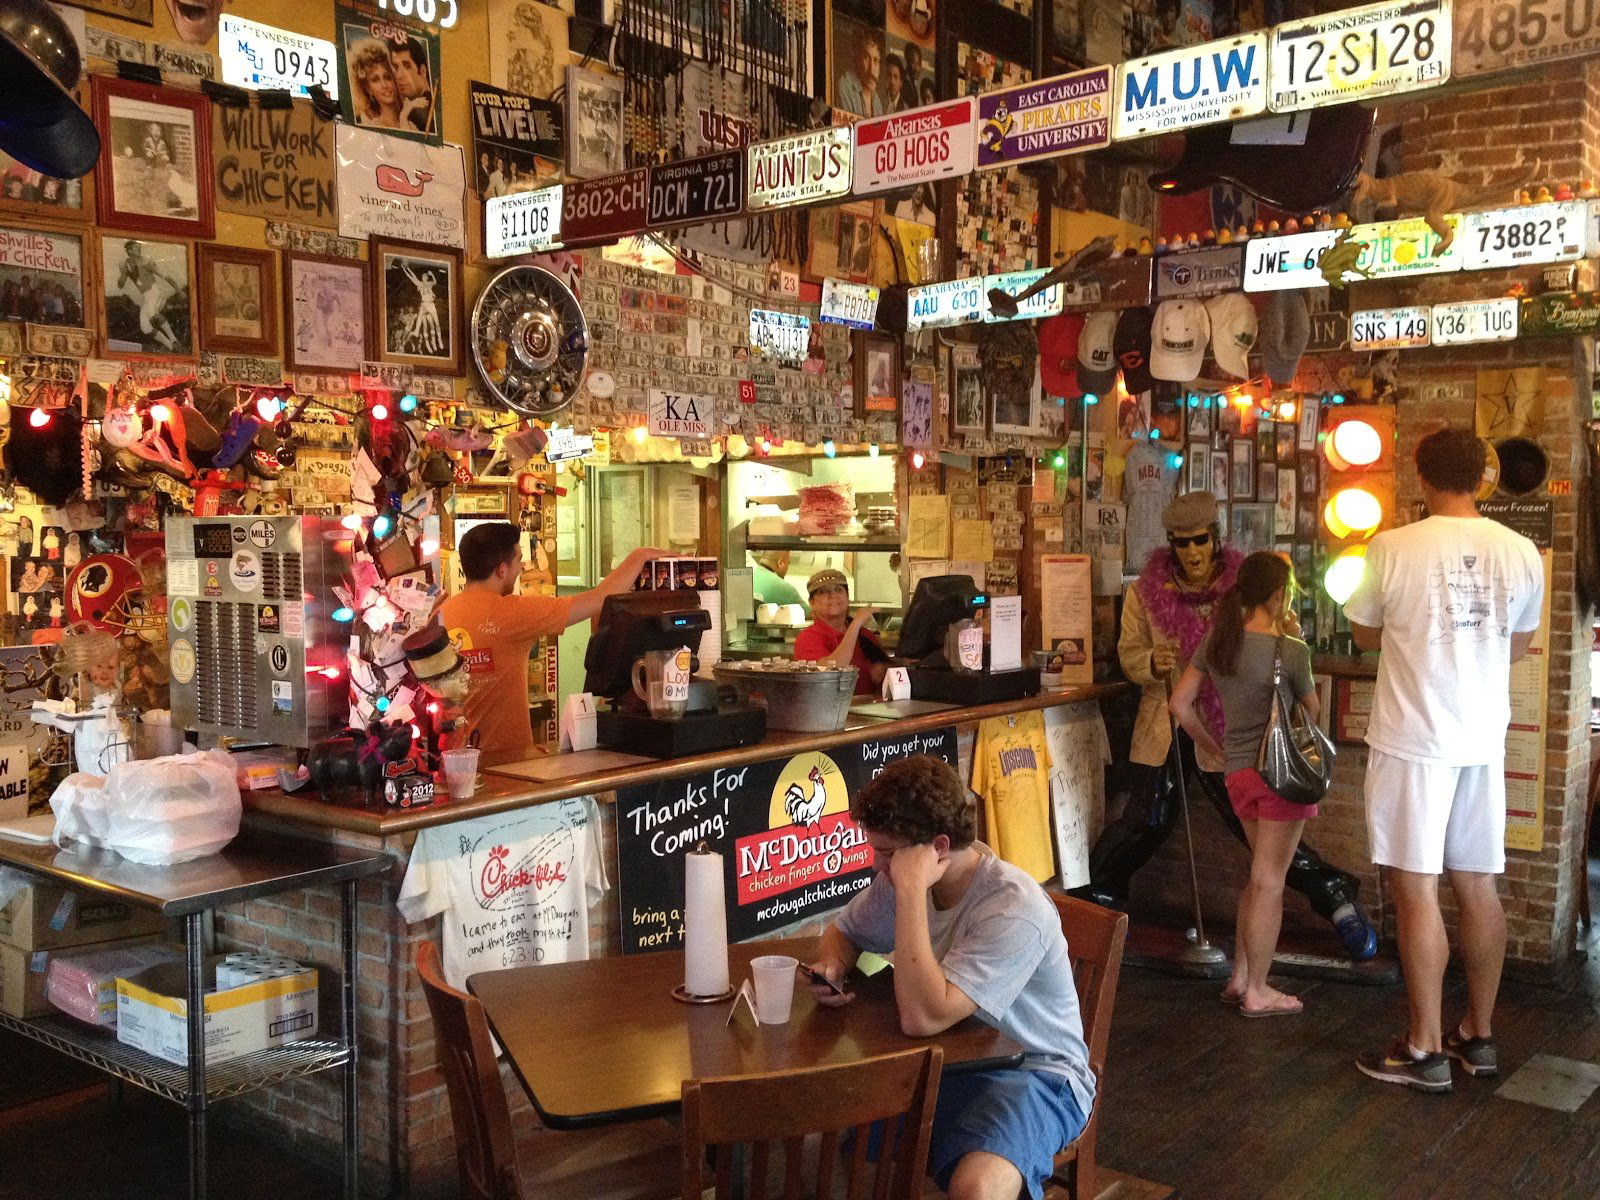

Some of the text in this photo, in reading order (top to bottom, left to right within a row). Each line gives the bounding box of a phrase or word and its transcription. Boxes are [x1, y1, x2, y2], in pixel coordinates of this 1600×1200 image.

[1317, 9, 1402, 32] TENNESSEE
[1460, 0, 1600, 58] 485-U
[250, 25, 311, 51] TENNESSEE
[369, 22, 409, 45] GREASE
[1287, 18, 1436, 84] 12-S128
[274, 47, 331, 86] 0943
[1125, 45, 1260, 112] M.U.W.
[503, 96, 531, 110] TOPS
[1018, 77, 1106, 108] EAST CAROLINA
[1021, 97, 1102, 131] PIRATES
[1127, 90, 1252, 122] MISSISSIPPI UNIVERSITY
[1157, 108, 1221, 128] FOR WOMEN
[475, 105, 538, 141] LIVE!
[884, 112, 942, 139] Arkansas
[771, 136, 825, 154] GEORGIA
[1017, 121, 1106, 151] UNIVERSITY
[260, 150, 297, 172] FOR
[875, 131, 950, 173] GO HOGS
[657, 158, 734, 181] VIRGINIA 1972
[886, 167, 936, 183] The Natural State
[217, 156, 335, 217] CHICKEN
[584, 175, 626, 190] MICHIGAN
[771, 184, 823, 200] PEACH STATE
[360, 194, 443, 218] vineyard vines
[505, 194, 551, 210] TENNESSEE
[511, 206, 550, 238] 1108
[1478, 220, 1553, 253] 73882
[1252, 252, 1289, 275] JWE
[783, 275, 796, 292] 23
[913, 289, 979, 318] AAU 630
[1354, 321, 1386, 343] SNS
[1395, 318, 1427, 341] 149
[1435, 314, 1465, 338] Y36
[1483, 310, 1513, 334] 1UG
[1091, 349, 1109, 362] CAT
[742, 385, 754, 399] 51
[658, 420, 706, 434] OLE MISS
[1137, 464, 1161, 482] MBA
[1480, 502, 1549, 513] Never Frozen!
[251, 530, 275, 539] MILES
[547, 648, 556, 694] SMITH
[896, 670, 903, 682] 2
[580, 698, 587, 713] 1
[862, 733, 945, 760] Did you get your
[412, 783, 434, 796] 2012
[626, 766, 748, 836] Thanks For
[650, 798, 730, 857] Coming!
[749, 850, 869, 893] chicken fingers wings
[757, 875, 871, 922] mcdougalschicken.com
[468, 922, 498, 938] came
[532, 910, 542, 920] at
[632, 907, 679, 927] bring a
[467, 941, 485, 958] and
[485, 936, 505, 952] they
[505, 929, 530, 943] took
[532, 929, 547, 942] my
[639, 925, 673, 947] next
